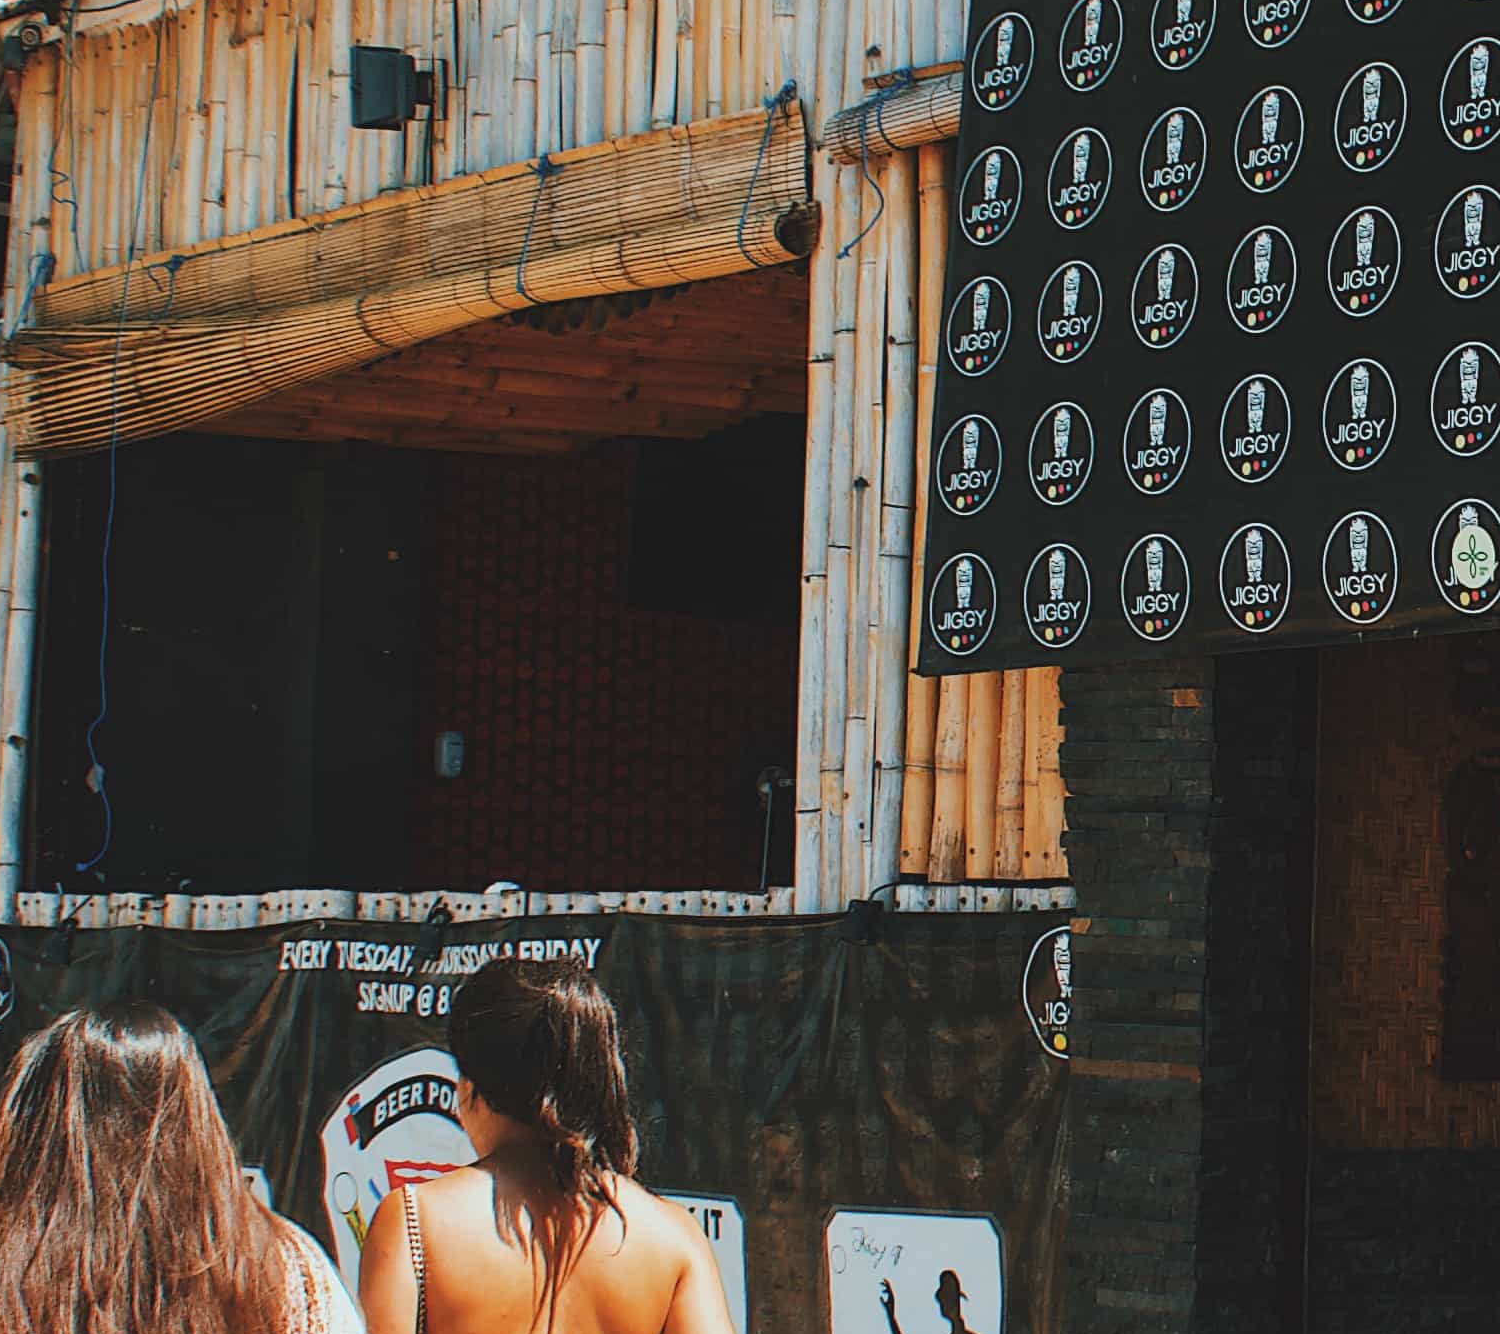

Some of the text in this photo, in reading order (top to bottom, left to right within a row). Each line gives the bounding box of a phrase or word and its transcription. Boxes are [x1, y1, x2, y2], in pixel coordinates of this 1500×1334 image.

[1158, 20, 1206, 48] JIGGY
[979, 63, 1023, 89] JIGGY
[1343, 119, 1396, 148] JIGGY
[1243, 142, 1293, 169] JIGGY
[1148, 162, 1196, 188] JIGGY
[1055, 181, 1101, 206] JIGGY
[967, 199, 1012, 223] JIGGY
[1444, 245, 1500, 273] JIGGY
[1337, 264, 1390, 291] JIGGY
[1139, 299, 1188, 325] JIGGY
[1045, 315, 1092, 339] JIGGY
[1441, 403, 1497, 430] JIGGY
[1332, 419, 1386, 444] JIGGY
[1132, 446, 1180, 469] JIGGY
[1229, 433, 1280, 458] JIGGY
[945, 469, 992, 491] JIGGY
[1036, 458, 1084, 481] JIGGY
[1230, 583, 1281, 606] JIGGY
[937, 609, 987, 630] JIGGY
[1033, 601, 1081, 622] JIGGY
[278, 940, 333, 971] EVERY
[373, 1082, 424, 1128] BEER
